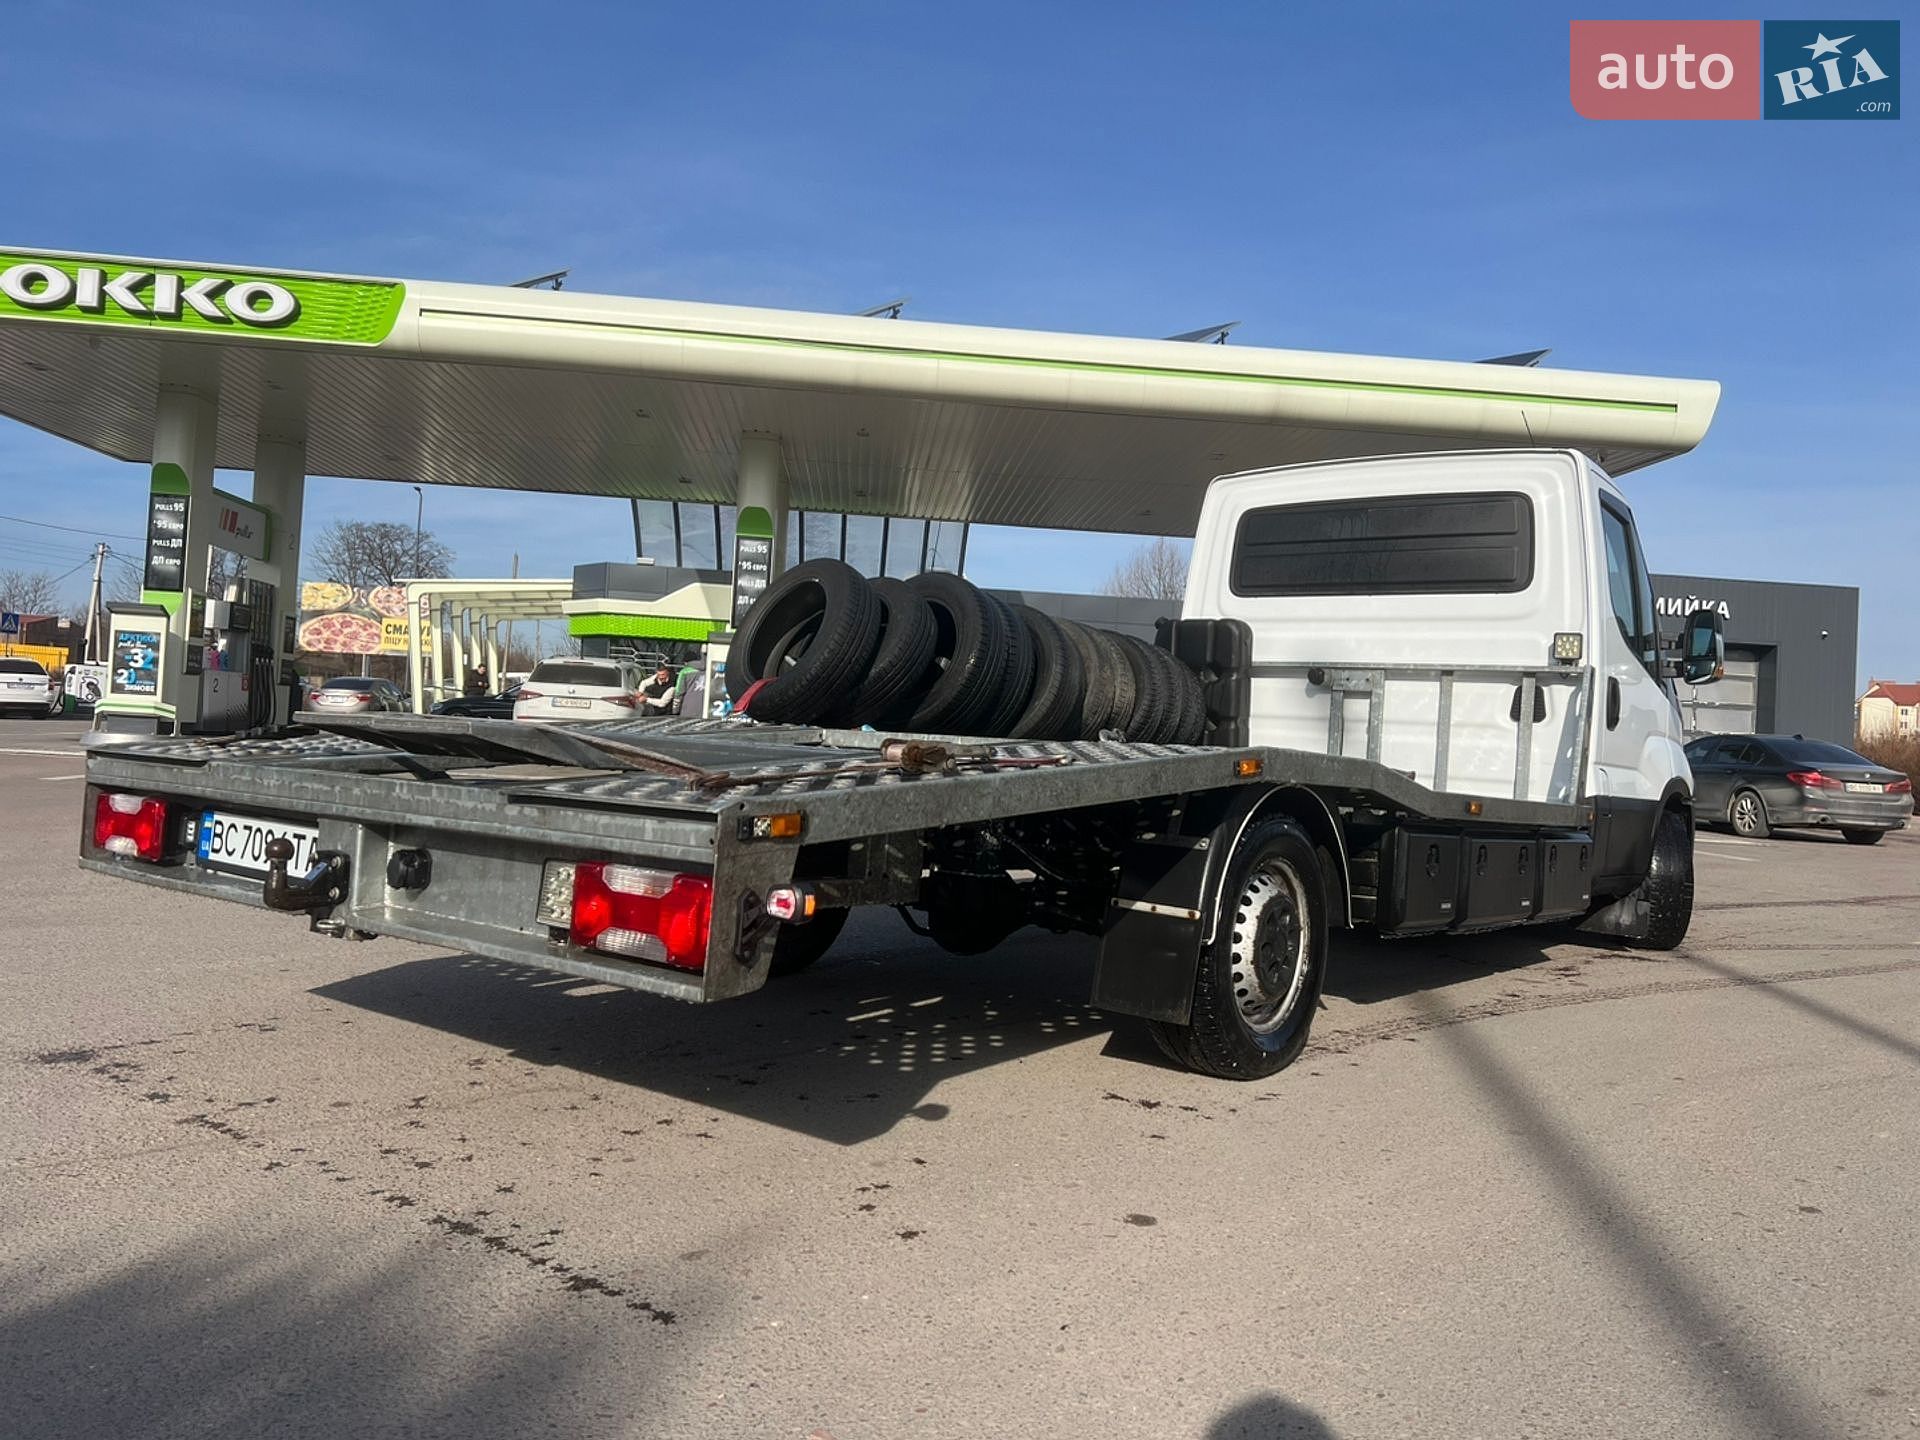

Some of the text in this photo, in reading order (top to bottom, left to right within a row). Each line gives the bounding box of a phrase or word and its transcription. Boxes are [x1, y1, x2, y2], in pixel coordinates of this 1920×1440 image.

[173, 502, 184, 512] 95
[757, 545, 768, 554] 95
[212, 678, 219, 693] 2
[211, 819, 239, 857] BC
[240, 825, 287, 864] 709
